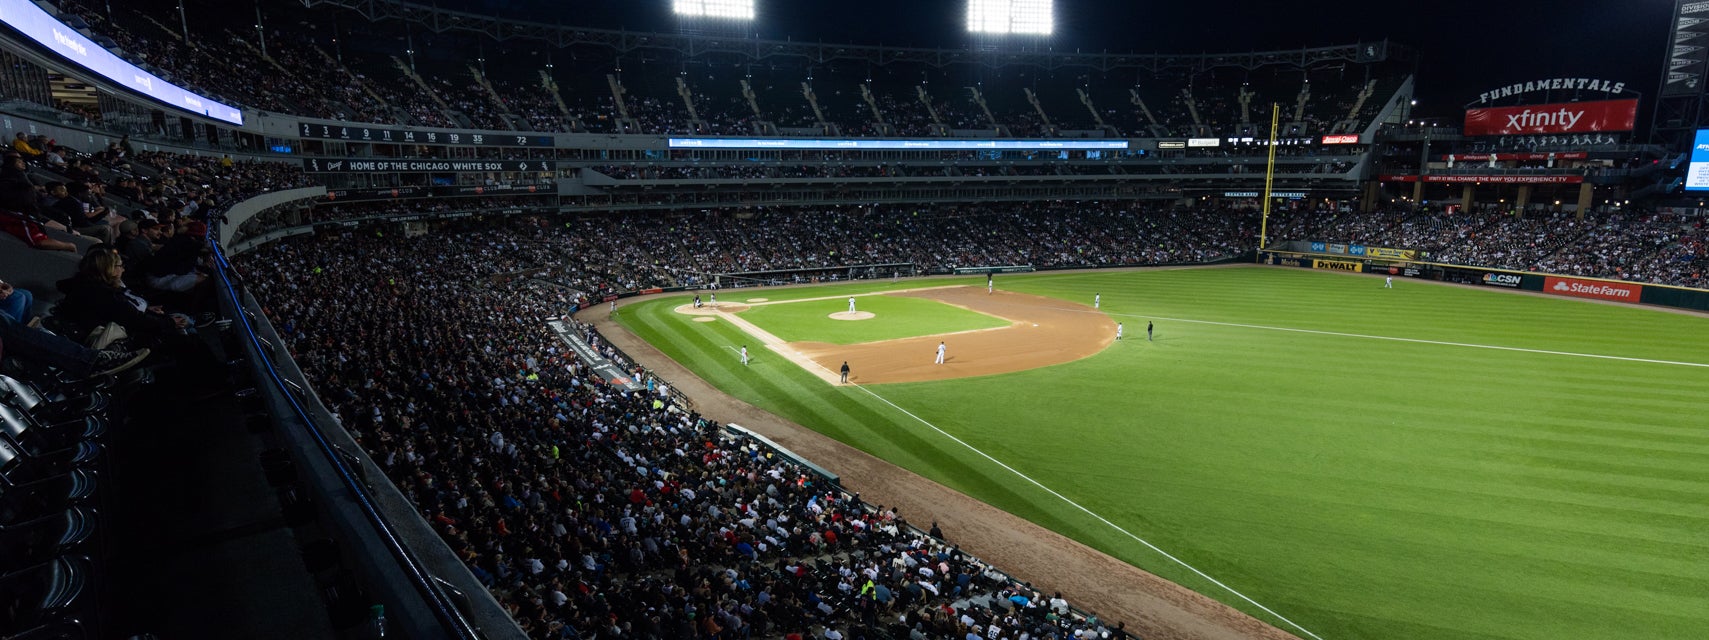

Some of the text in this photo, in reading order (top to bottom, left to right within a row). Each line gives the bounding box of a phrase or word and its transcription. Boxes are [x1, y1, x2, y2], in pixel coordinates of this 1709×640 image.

[1480, 78, 1626, 104] FUNDAMENTALS
[1506, 108, 1585, 131] xfinity
[304, 124, 527, 144] 2 3 4 9 11 14 16 19 35 72
[350, 162, 375, 170] HOME
[377, 162, 388, 170] OF
[390, 162, 408, 170] THE
[410, 162, 449, 170] CHICAGO
[452, 162, 483, 170] WHITE
[1497, 274, 1522, 284] CSN
